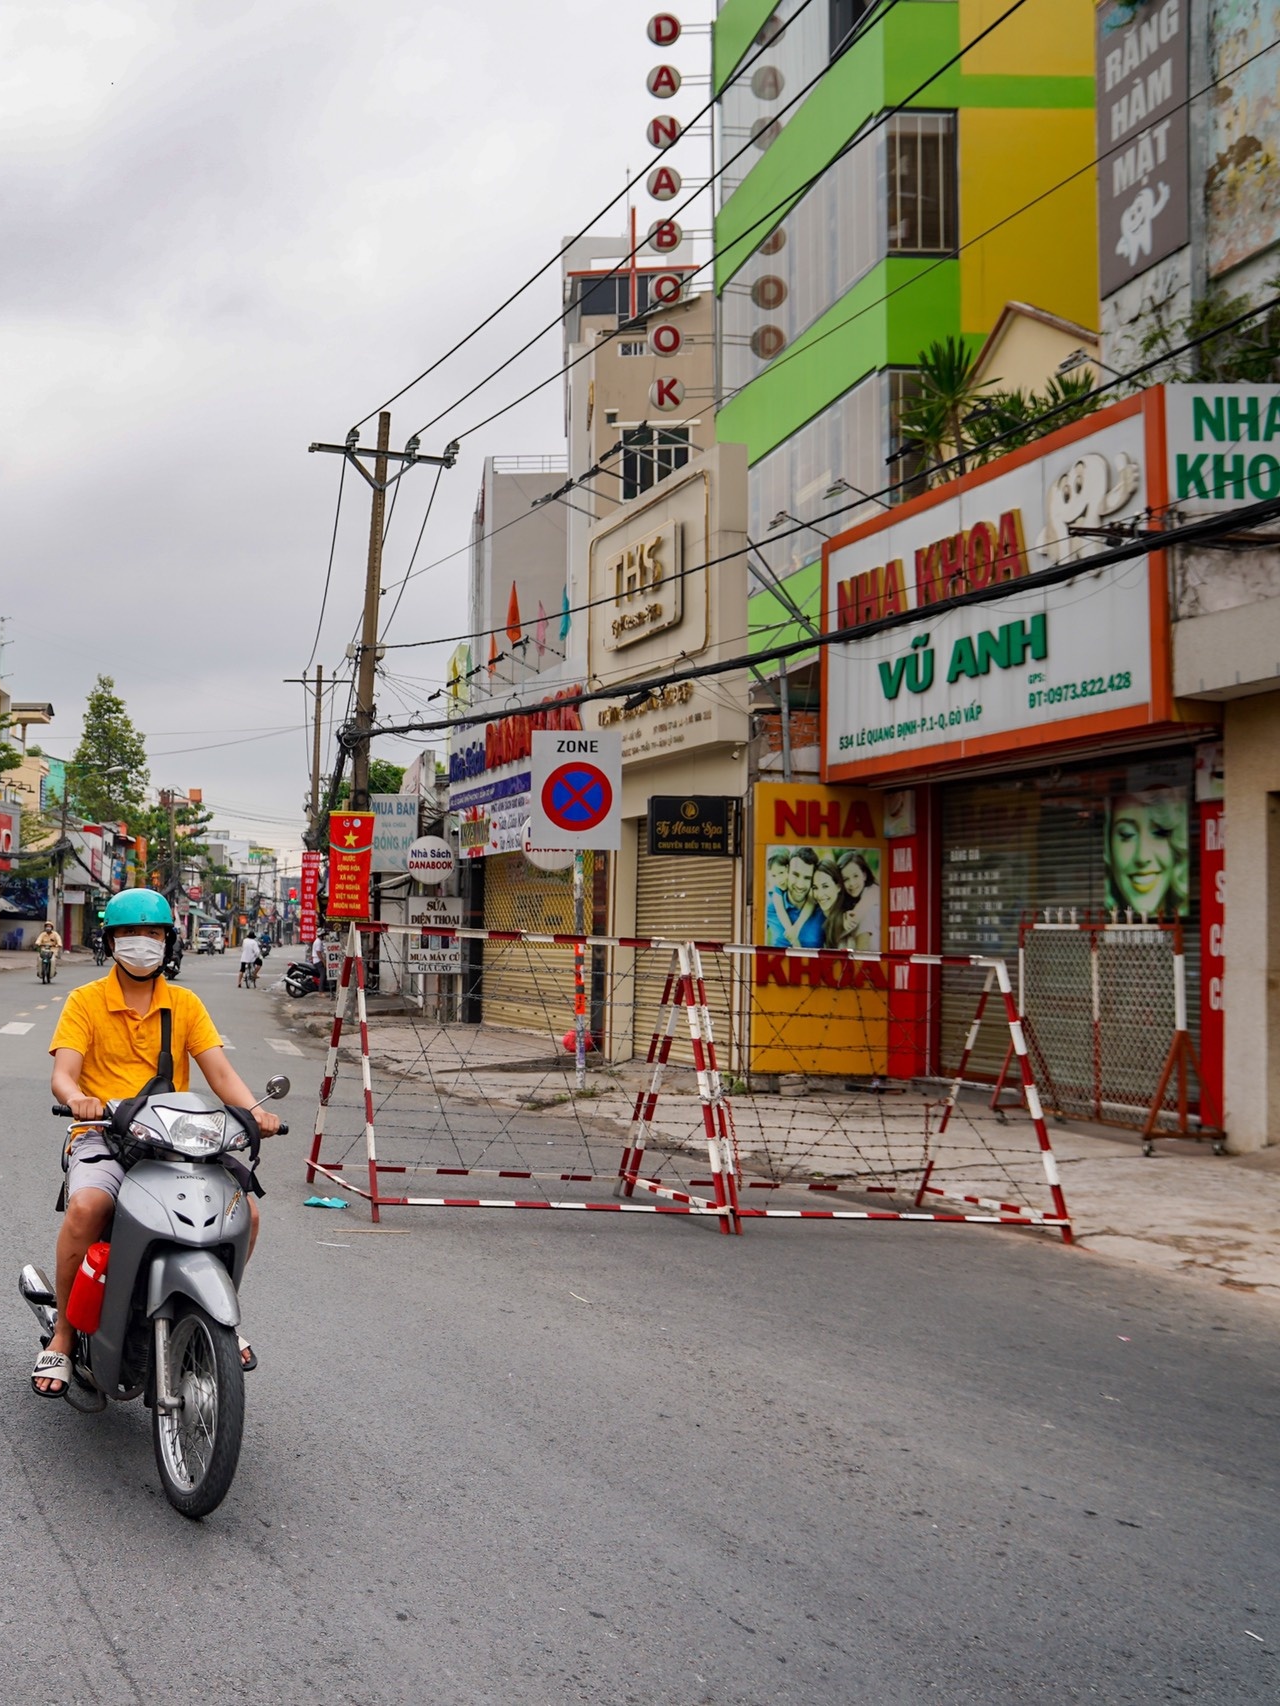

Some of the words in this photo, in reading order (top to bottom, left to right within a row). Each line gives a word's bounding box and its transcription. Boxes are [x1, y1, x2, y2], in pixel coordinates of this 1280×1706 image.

[1111, 58, 1172, 142] HÀM
[837, 559, 908, 630] NHA
[914, 508, 1029, 608] KHOA
[877, 633, 936, 700] VŨ
[947, 612, 1048, 685] ANH
[556, 740, 599, 754] ZONE
[839, 735, 854, 750] 534
[867, 726, 895, 745] QUANG
[372, 802, 394, 815] MUA
[397, 799, 416, 815] BÁN
[774, 799, 876, 838] NHA
[408, 861, 453, 870] DANABOOK
[411, 847, 428, 858] Nhà
[430, 848, 451, 859] Sách
[893, 847, 913, 873] NHA
[890, 886, 915, 912] KHOA
[433, 914, 460, 927] THOẠI
[429, 952, 447, 961] MÁY
[756, 952, 888, 988] KHOA
